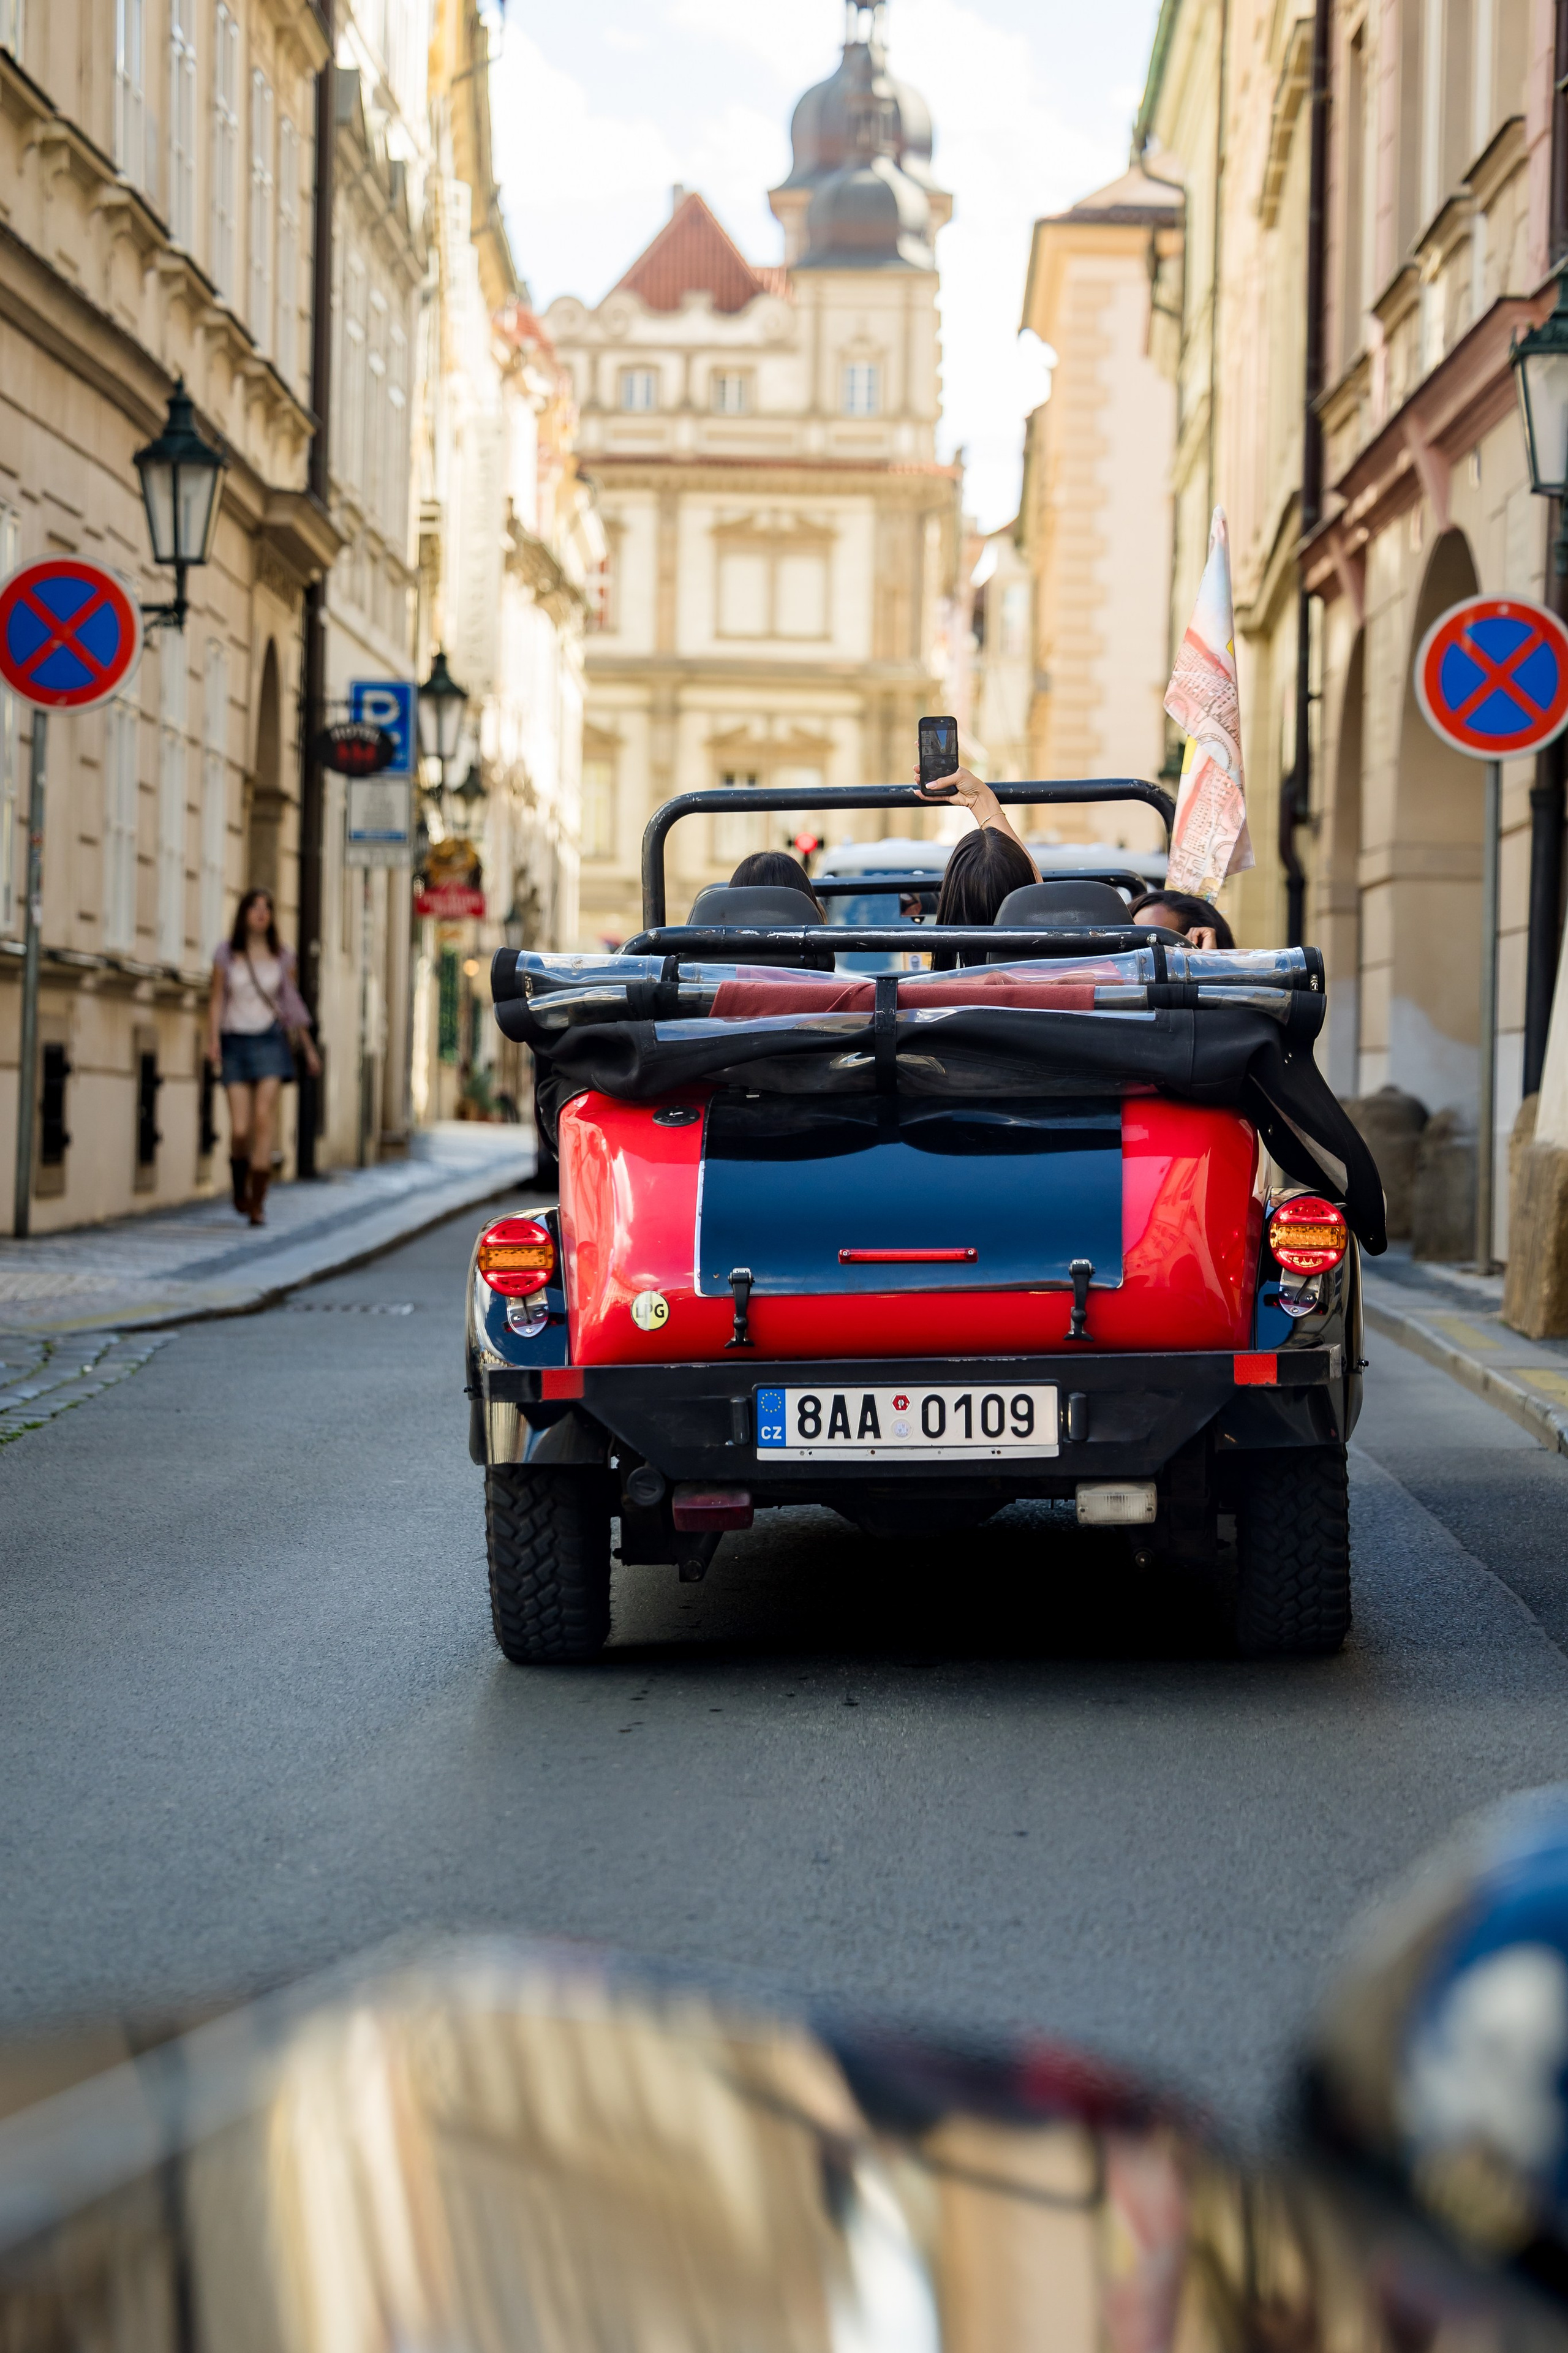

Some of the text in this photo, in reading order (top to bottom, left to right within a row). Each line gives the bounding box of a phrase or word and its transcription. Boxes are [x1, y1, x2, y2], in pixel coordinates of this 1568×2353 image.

[362, 690, 400, 727] P
[761, 1426, 782, 1440] CZ
[797, 1394, 881, 1440] 8AA
[921, 1393, 1035, 1439] 0109
